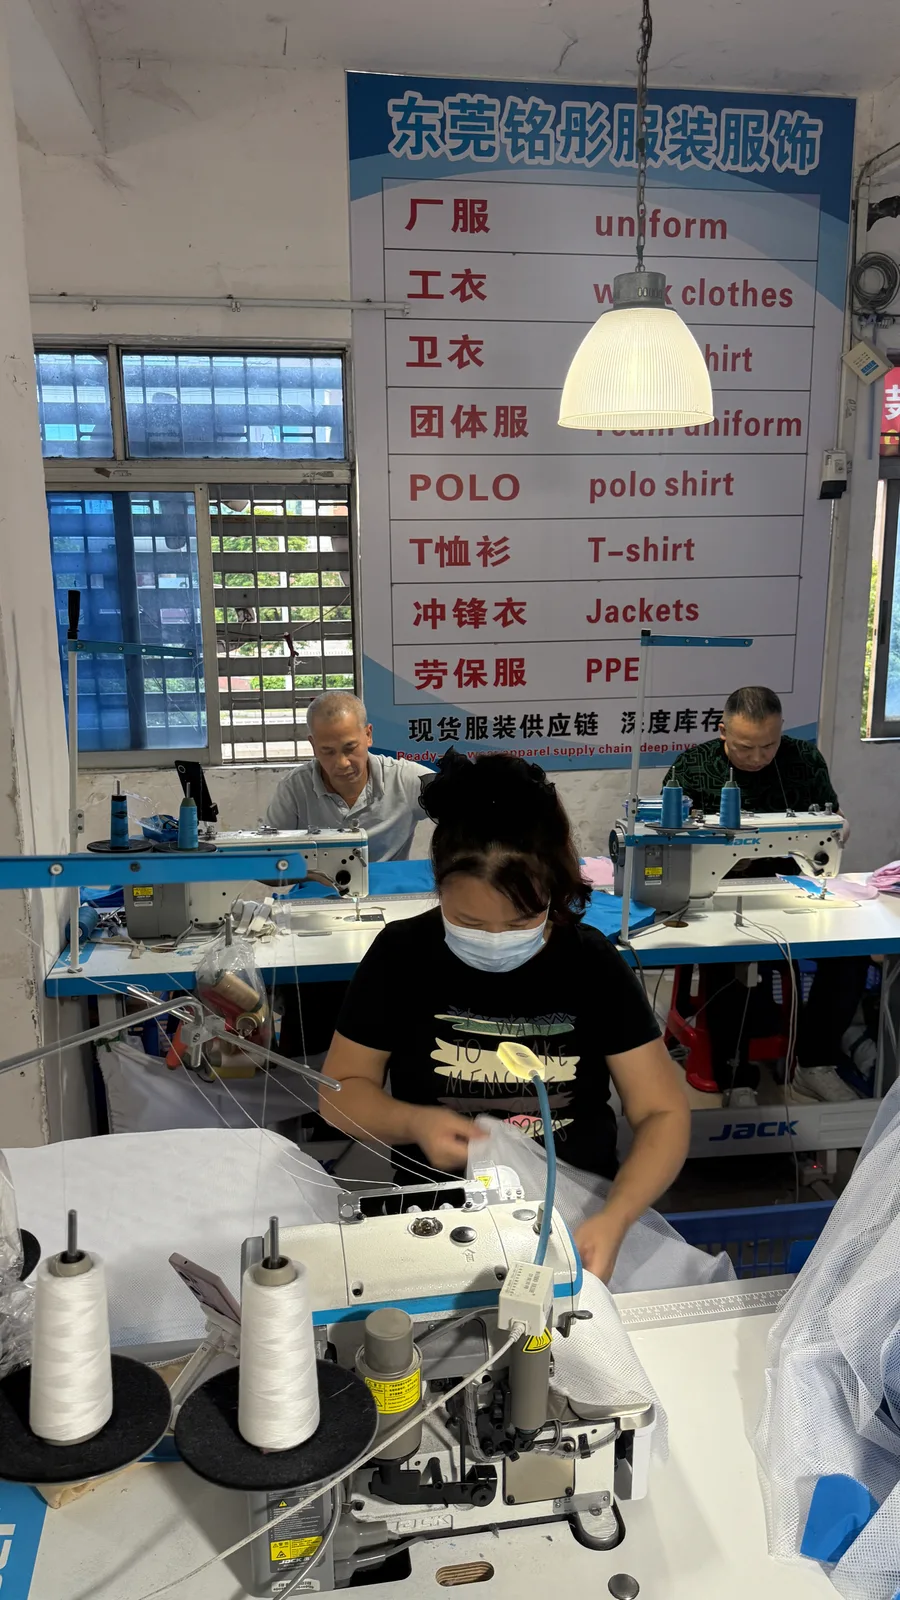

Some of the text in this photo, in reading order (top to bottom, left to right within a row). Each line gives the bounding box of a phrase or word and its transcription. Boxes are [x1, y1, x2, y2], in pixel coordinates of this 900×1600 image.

[388, 91, 822, 175] 东莞铭彤服装服饰
[405, 198, 490, 234] 厂服
[407, 267, 488, 304] 工衣
[681, 278, 793, 308] clothes
[405, 333, 485, 370] 卫衣
[409, 403, 529, 440] 团体服
[408, 472, 521, 503] POLO
[589, 470, 735, 505] polo shirt
[407, 534, 512, 569] T恤衫
[587, 535, 695, 564] T-shirt
[412, 596, 528, 632] 冲锋衣
[585, 596, 700, 625] Jackets
[413, 656, 528, 691] 劳保服
[585, 656, 641, 685] PPE
[408, 711, 599, 743] 现货服装供应链
[553, 744, 595, 757] supply
[598, 742, 632, 754] chain
[639, 741, 669, 754] deep
[452, 1038, 568, 1067] TO AKE
